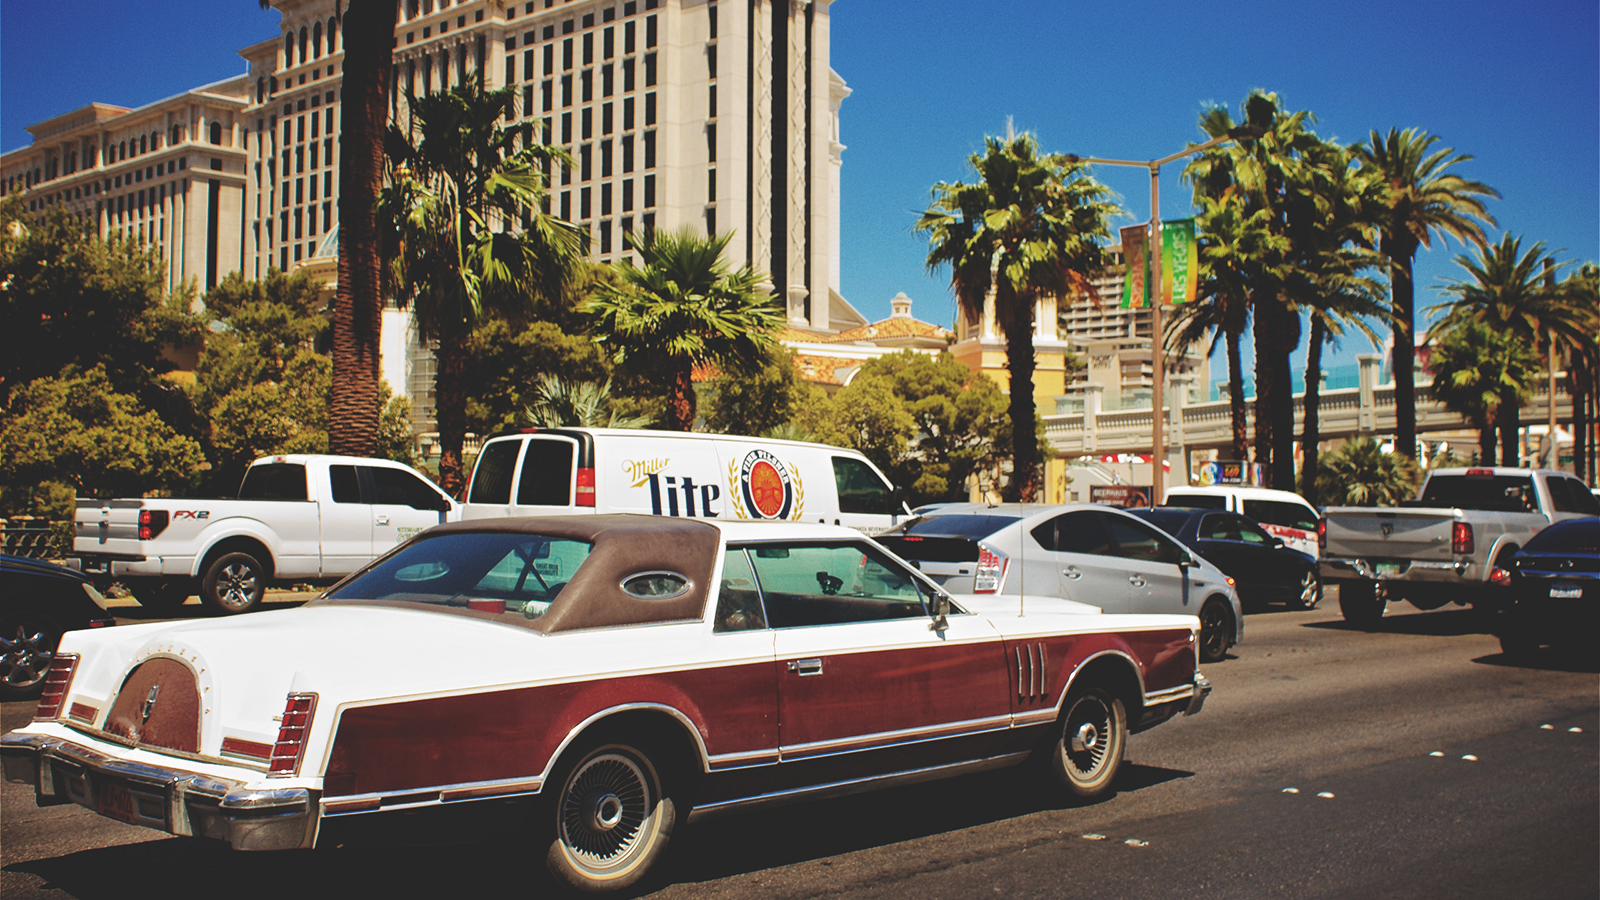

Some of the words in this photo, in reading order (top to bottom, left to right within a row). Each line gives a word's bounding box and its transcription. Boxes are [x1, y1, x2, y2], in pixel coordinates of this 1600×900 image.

[1172, 231, 1187, 274] VEGAS
[1172, 275, 1187, 300] LAS
[621, 457, 671, 483] Miller
[757, 450, 790, 484] PILSNER
[644, 473, 720, 518] lite
[172, 510, 210, 519] FX2
